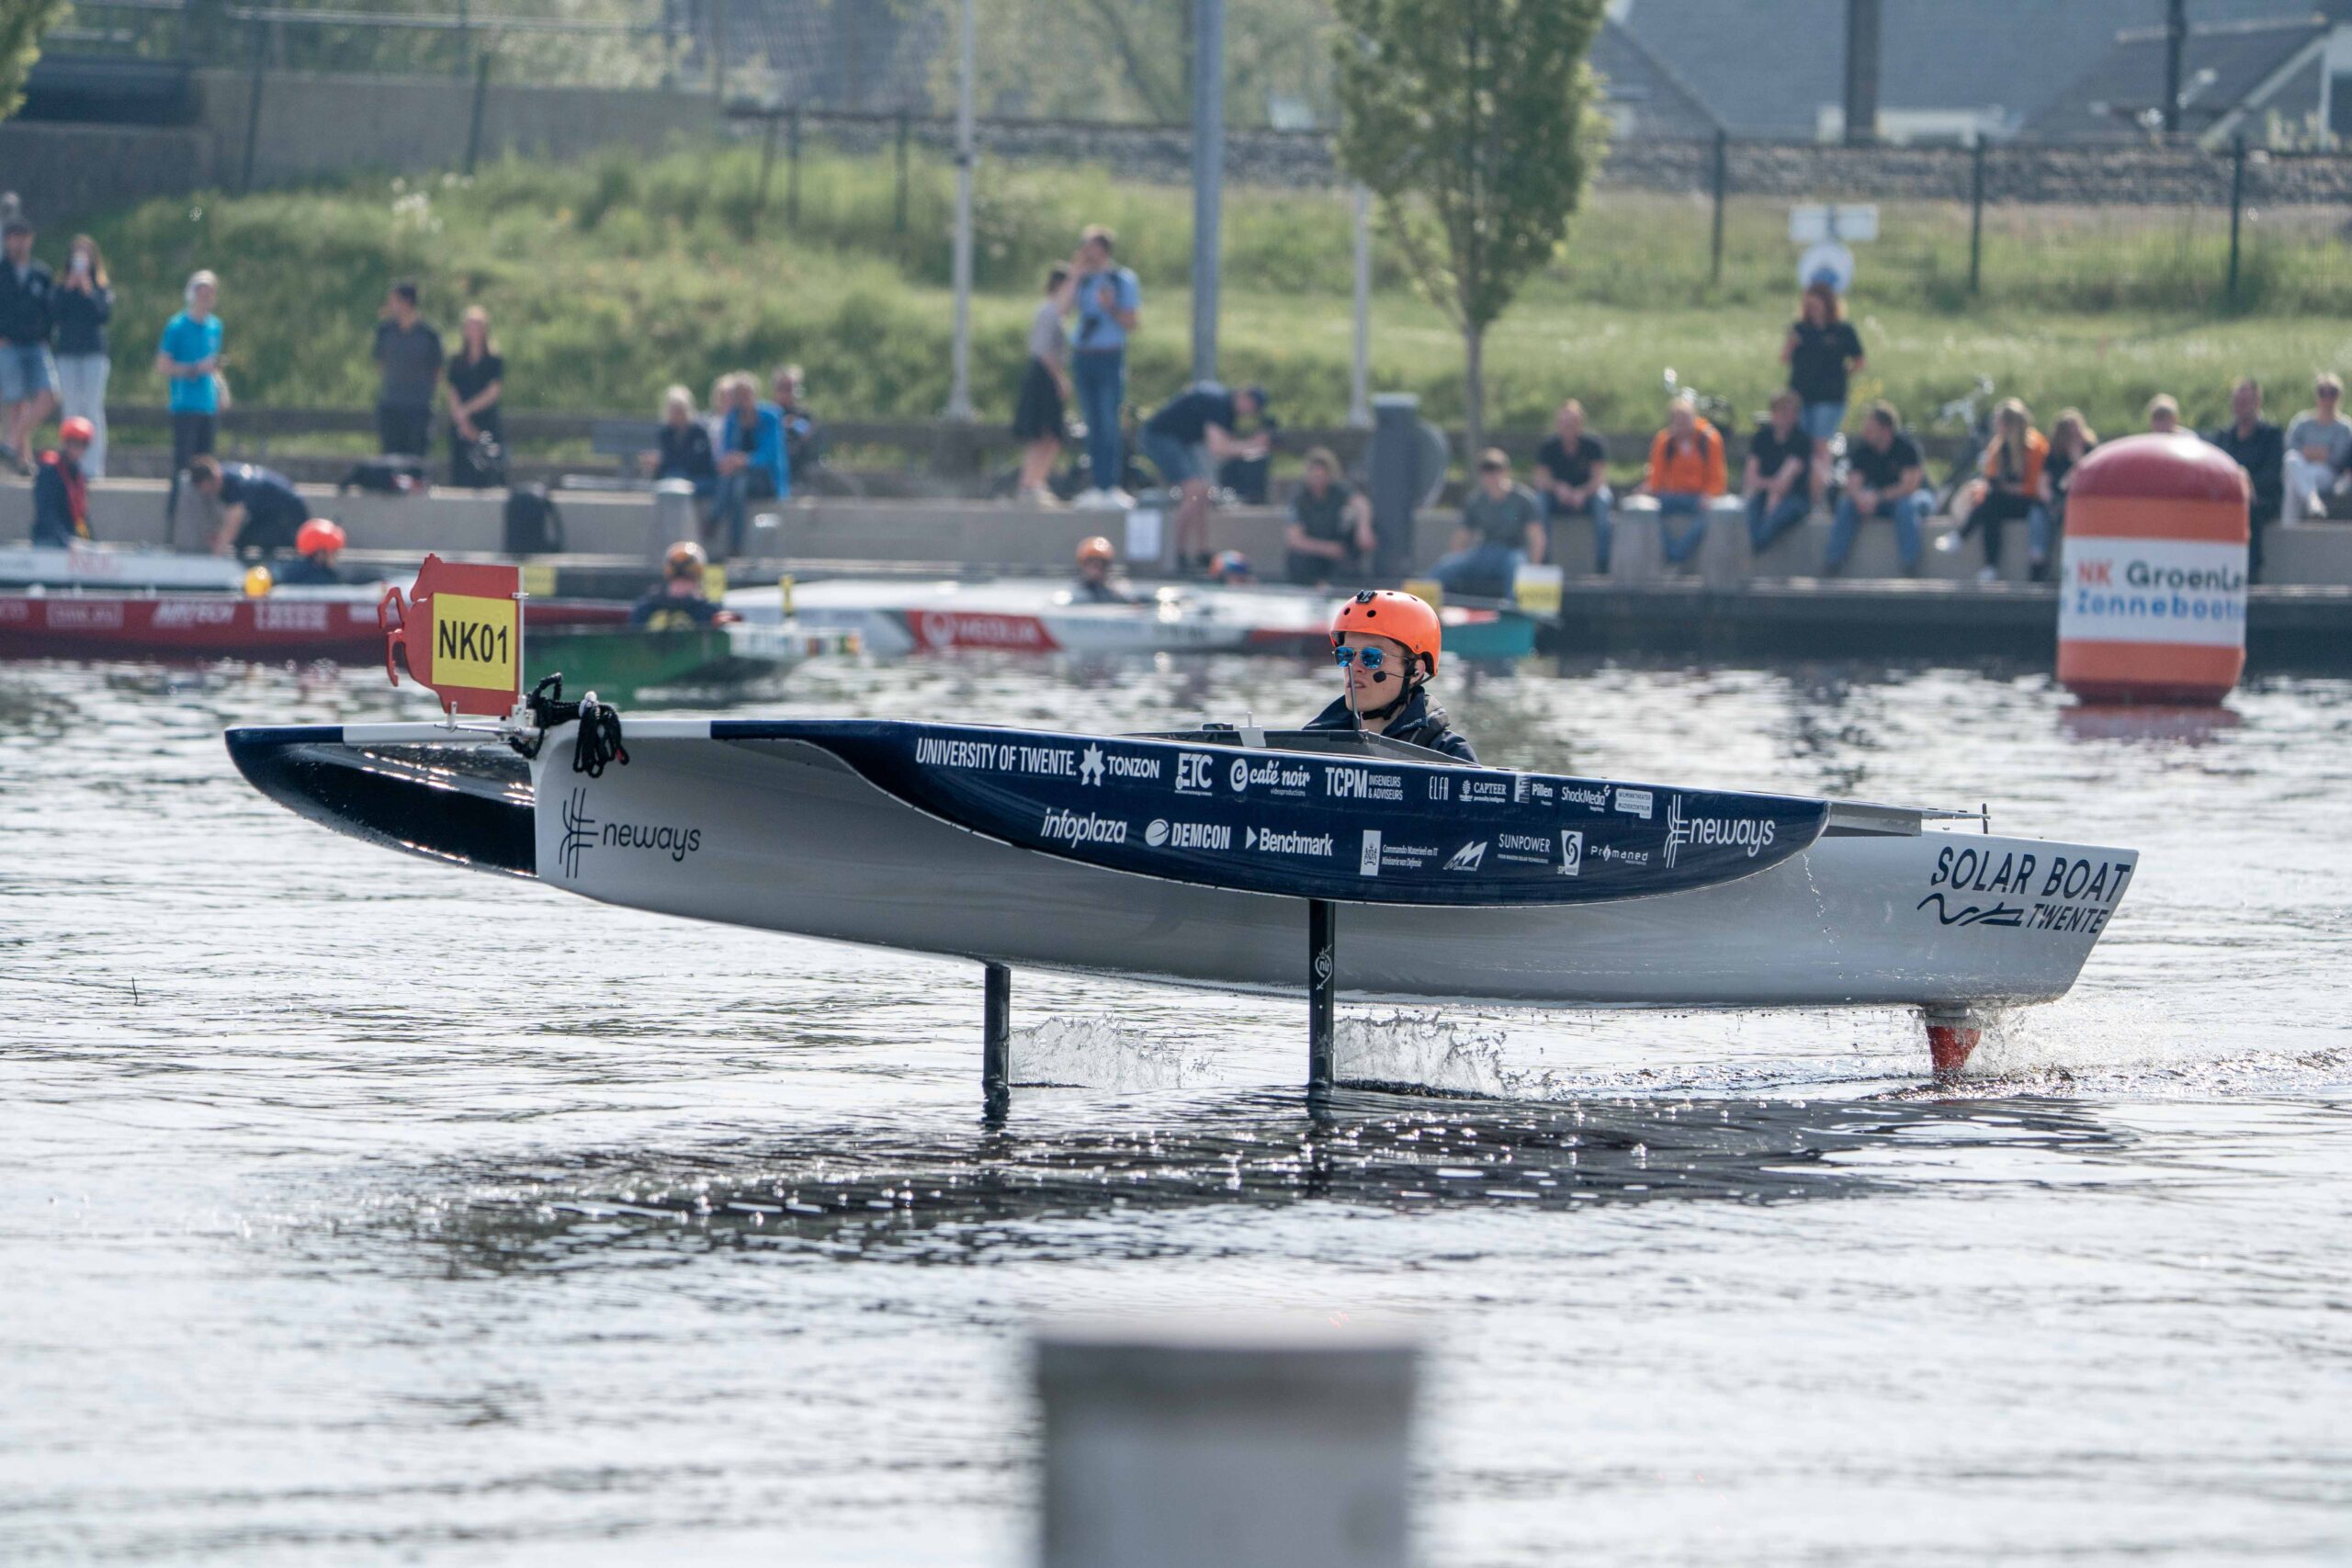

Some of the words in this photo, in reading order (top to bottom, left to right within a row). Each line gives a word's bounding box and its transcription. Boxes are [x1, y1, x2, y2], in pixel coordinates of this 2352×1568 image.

[2077, 559, 2113, 585] NK
[438, 619, 507, 664] NK01
[915, 738, 997, 770] UNIVERSITY
[999, 744, 1017, 772] OF
[1019, 746, 1077, 776] TWENTE.
[1107, 755, 1160, 779] TONZON
[1175, 752, 1214, 790] ETC
[1250, 760, 1280, 785] café
[1282, 764, 1311, 787] noir
[1325, 766, 1368, 798] TCPM
[1369, 773, 1402, 787] INGENIEURS
[1368, 787, 1373, 799] &
[1374, 788, 1404, 801] ADVISEURS
[1473, 782, 1507, 795] CAPTEER
[1532, 783, 1553, 797] Pillen
[1040, 807, 1128, 849] infoplaza
[1170, 822, 1231, 850] DEMCON
[1259, 828, 1334, 856] Benchmark
[1498, 833, 1550, 852] SUNPOWER
[1930, 846, 2036, 895] SOLAR
[2041, 856, 2132, 903] BOAT
[2026, 903, 2109, 934] TWENTE
